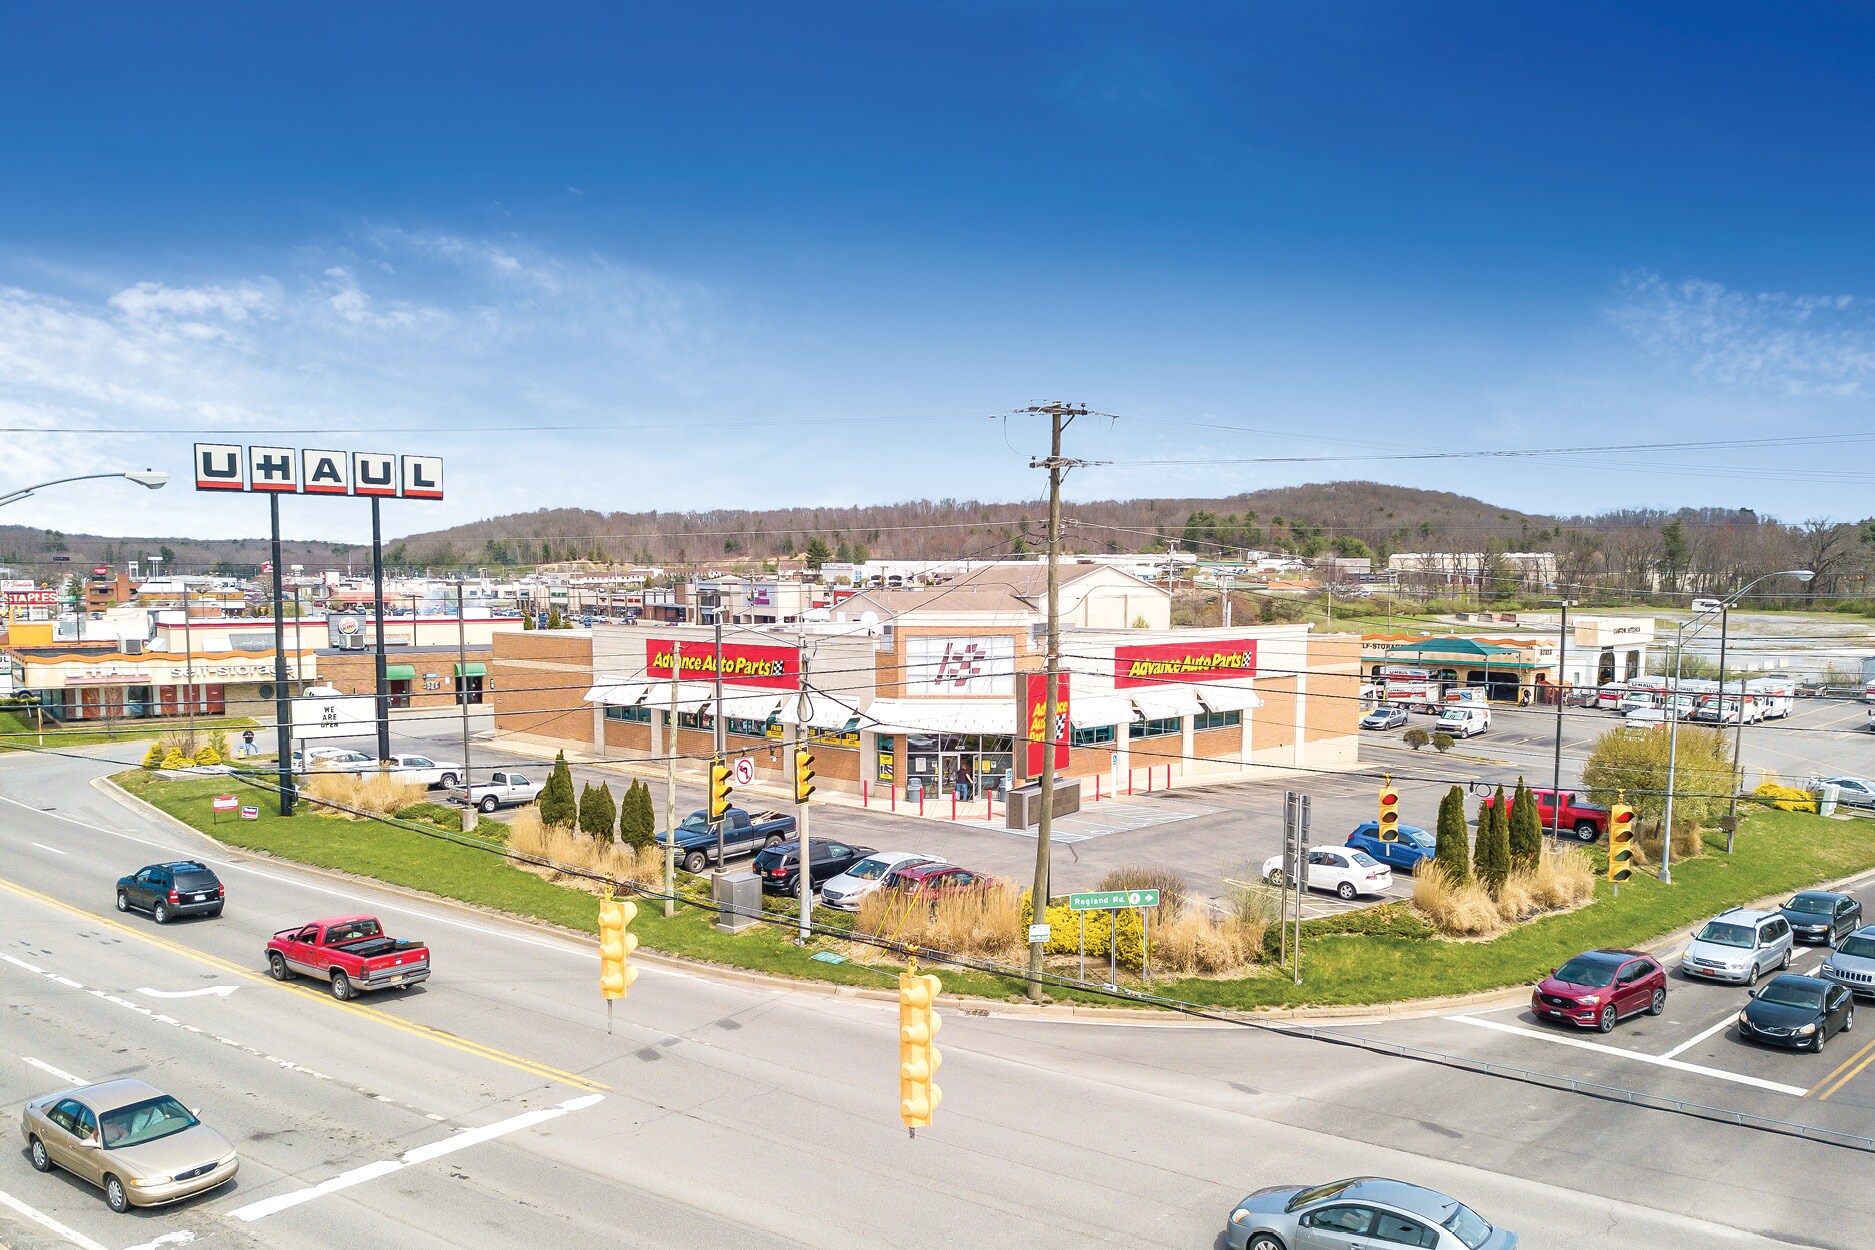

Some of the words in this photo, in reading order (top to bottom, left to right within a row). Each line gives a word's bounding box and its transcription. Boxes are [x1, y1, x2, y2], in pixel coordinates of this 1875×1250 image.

[735, 657, 771, 676] Parts
[1128, 659, 1181, 677] Advance
[1180, 655, 1212, 673] Auto
[1212, 652, 1242, 670] Parts
[322, 713, 337, 721] ARE
[1074, 897, 1109, 906] Ragland
